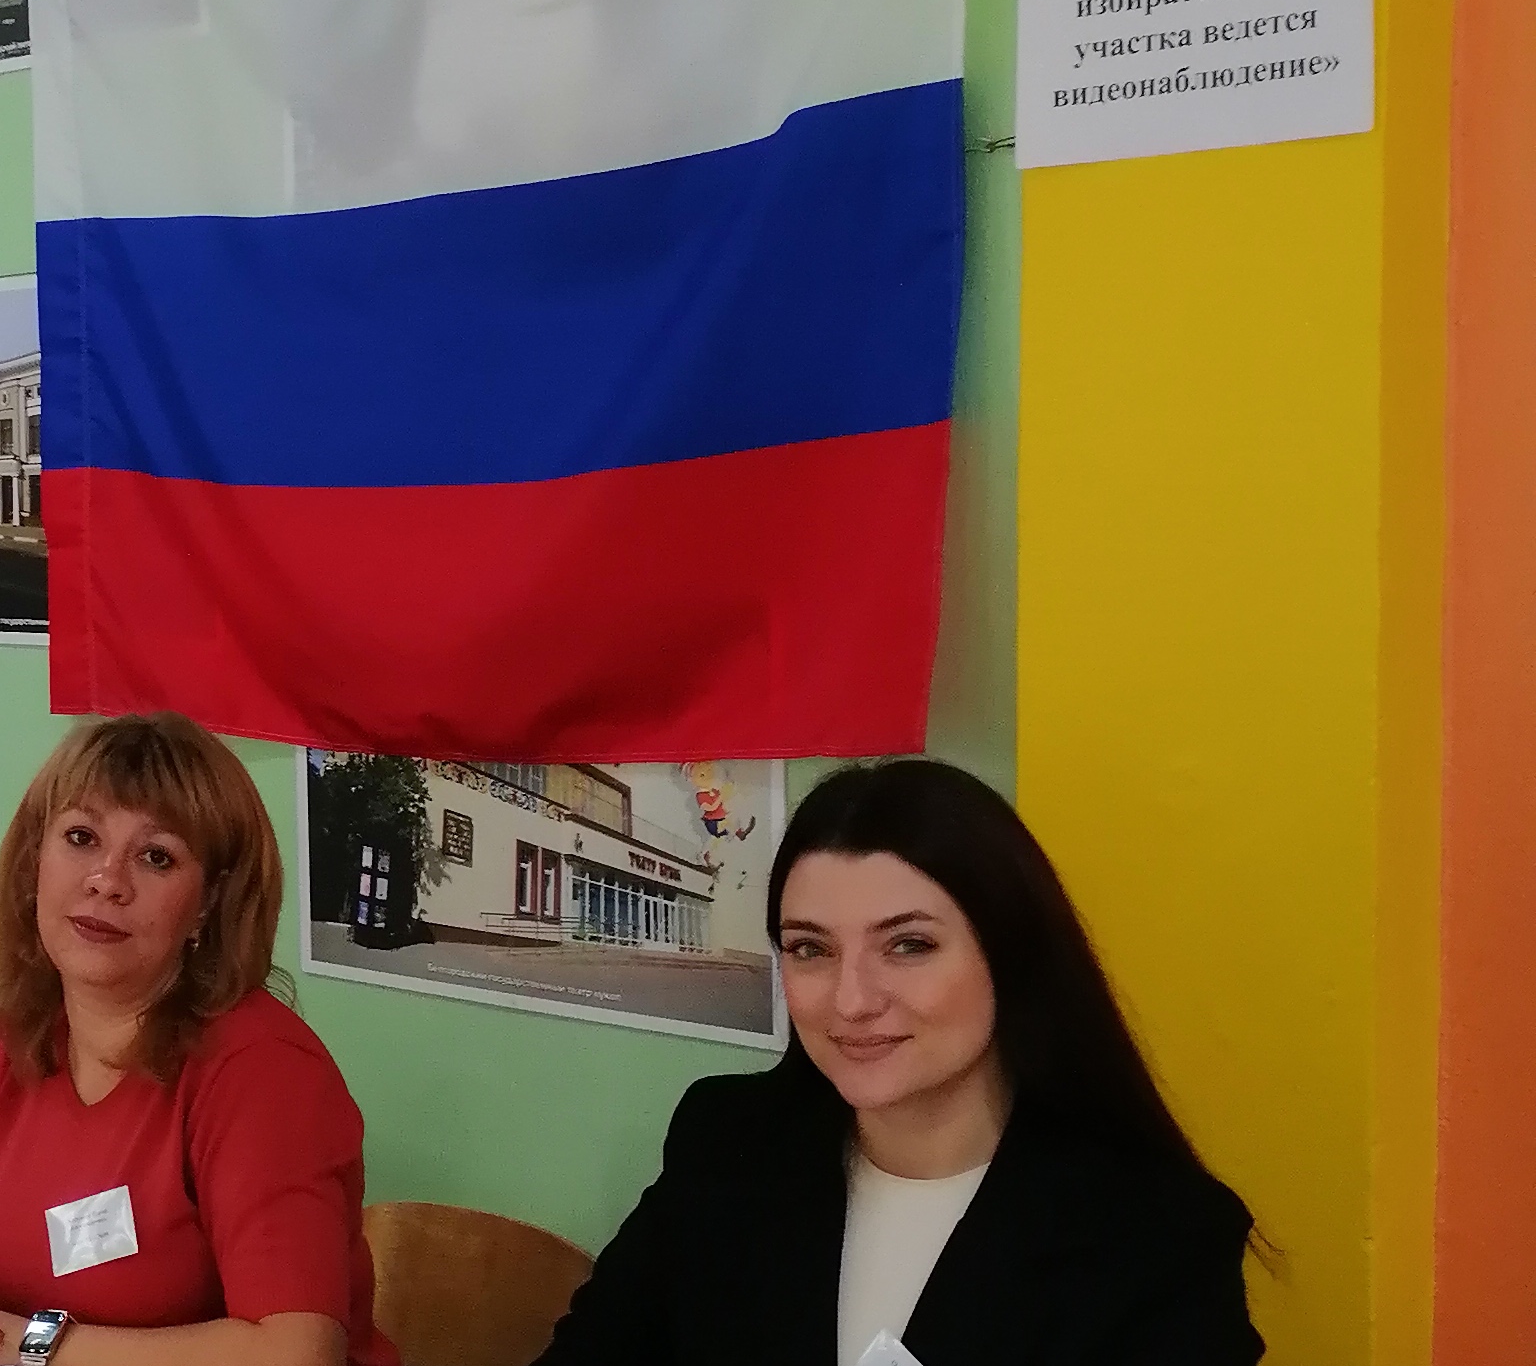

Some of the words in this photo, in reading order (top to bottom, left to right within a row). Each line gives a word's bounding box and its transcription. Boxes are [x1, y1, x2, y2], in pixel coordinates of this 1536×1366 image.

[1072, 25, 1193, 69] участка
[1203, 8, 1320, 46] ведется
[1052, 52, 1342, 109] видеонаблюдение»
